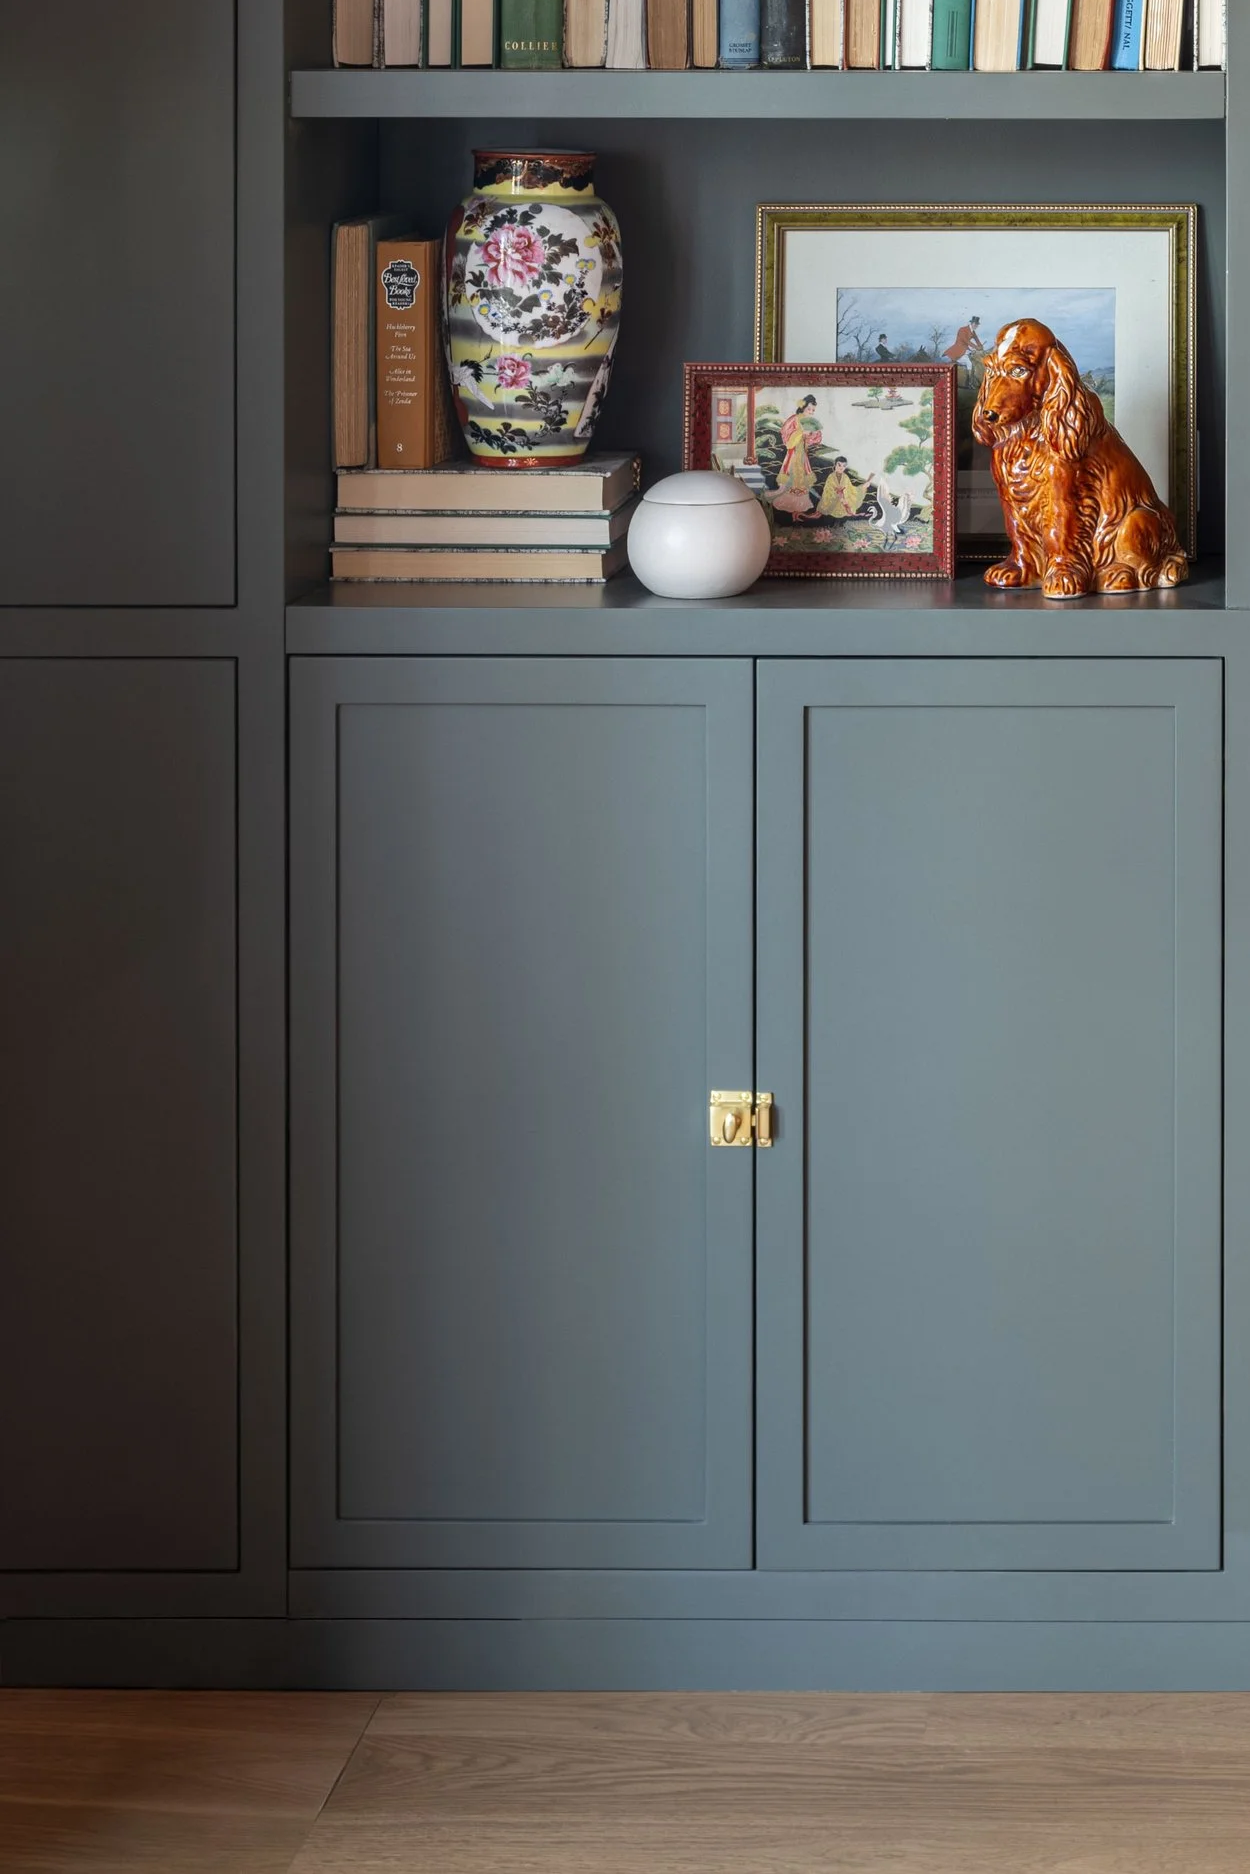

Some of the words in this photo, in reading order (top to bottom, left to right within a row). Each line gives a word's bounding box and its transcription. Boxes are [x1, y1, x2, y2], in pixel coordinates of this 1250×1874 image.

[389, 286, 412, 297] Books
[386, 323, 416, 332] Huckleberry
[397, 443, 403, 452] 8
